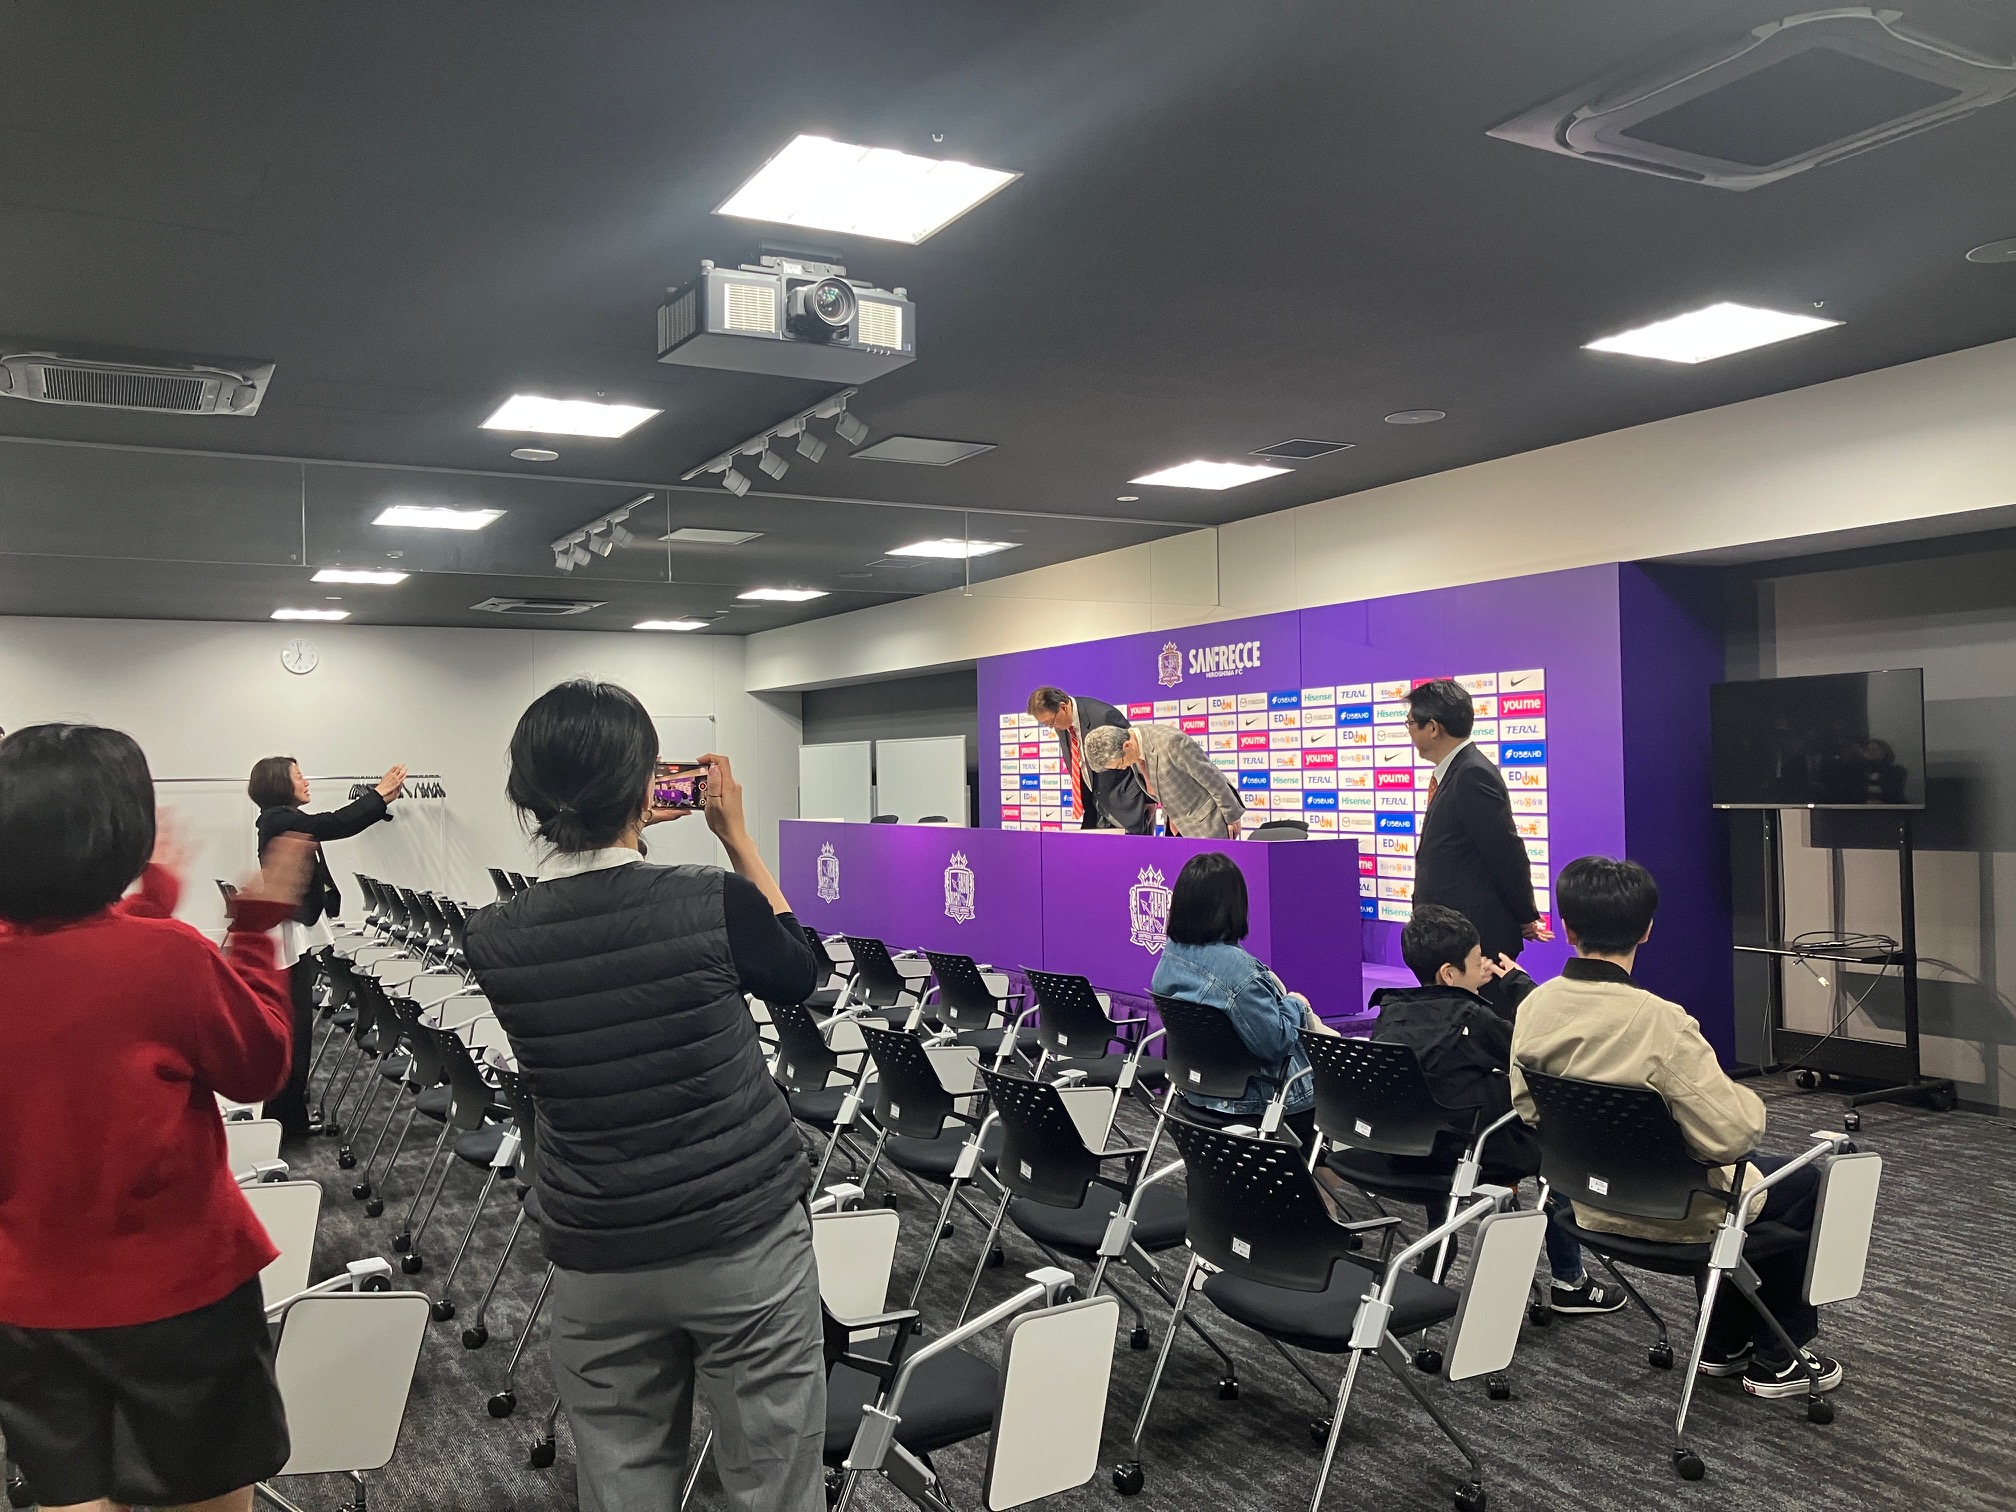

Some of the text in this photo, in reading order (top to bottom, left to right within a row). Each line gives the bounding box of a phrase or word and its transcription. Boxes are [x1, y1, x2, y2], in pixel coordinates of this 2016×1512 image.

[1188, 641, 1261, 675] SANFRECCE
[1205, 668, 1243, 679] HIROSHIMA FC
[1304, 693, 1332, 702] Hisense
[1341, 689, 1367, 699] TERAL
[1129, 705, 1151, 717] youme
[1503, 698, 1541, 713] youme
[1274, 713, 1296, 726] EDION
[1376, 709, 1408, 718] Hisense
[1182, 719, 1205, 731] youme
[1505, 725, 1539, 734] TERAL
[1240, 735, 1266, 747] youme
[1343, 730, 1367, 743] EDION
[1021, 746, 1038, 756] youme
[1212, 758, 1235, 766] Hisense
[1305, 753, 1334, 765] youme
[1308, 776, 1332, 784] TERAL
[1378, 773, 1410, 786] youme
[1508, 771, 1539, 786] EDION
[1245, 794, 1265, 806] EDION
[1342, 797, 1371, 805] Hisense
[1381, 797, 1408, 805] TERAL
[1003, 808, 1019, 817] youme
[1310, 815, 1332, 828] EDION
[1383, 838, 1408, 852] EDION
[1588, 1286, 1604, 1303] N
